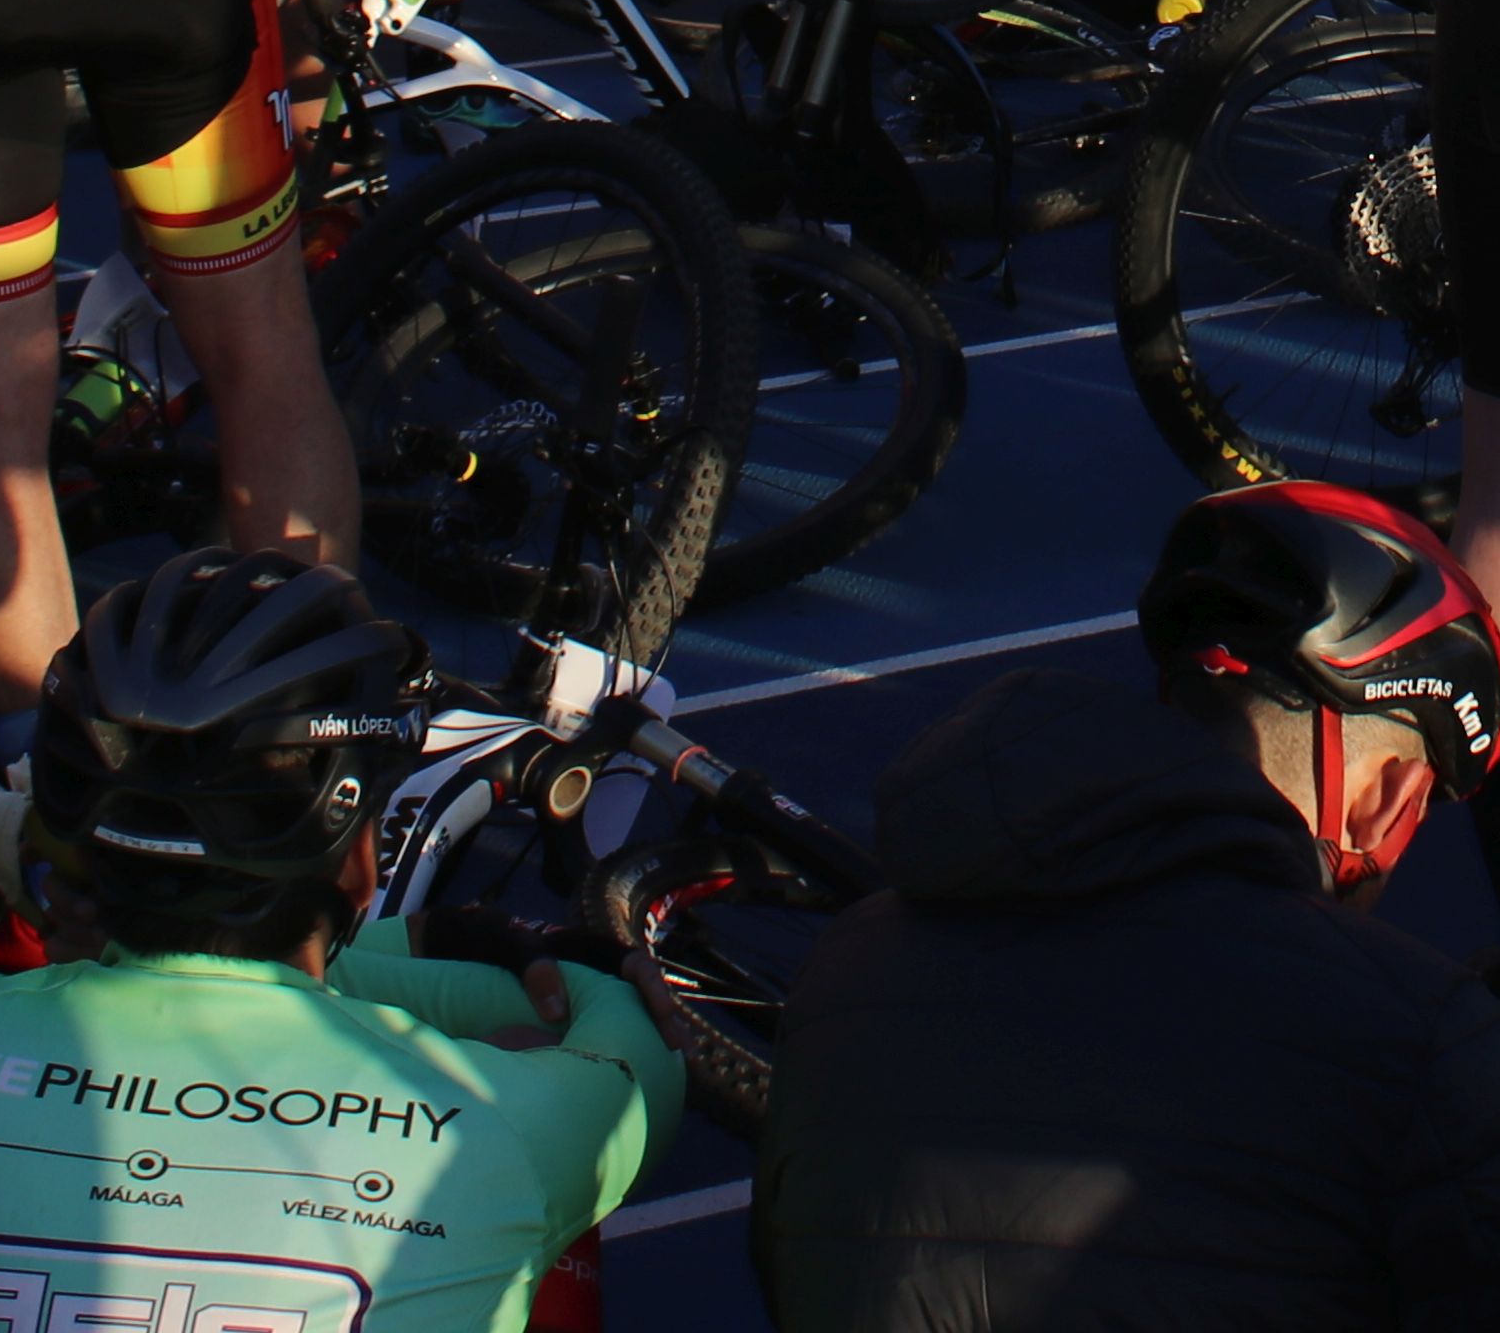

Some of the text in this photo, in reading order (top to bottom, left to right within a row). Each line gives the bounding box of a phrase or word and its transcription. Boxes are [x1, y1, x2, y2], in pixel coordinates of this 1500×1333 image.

[244, 214, 271, 239] LA
[1364, 677, 1453, 701] BICICLETAS
[1452, 691, 1483, 737] Km
[310, 712, 392, 738] IVÁN LÓPEZ
[88, 1183, 184, 1209] MÁLAGA
[282, 1199, 447, 1240] VÉLEZ MÁLAGA
